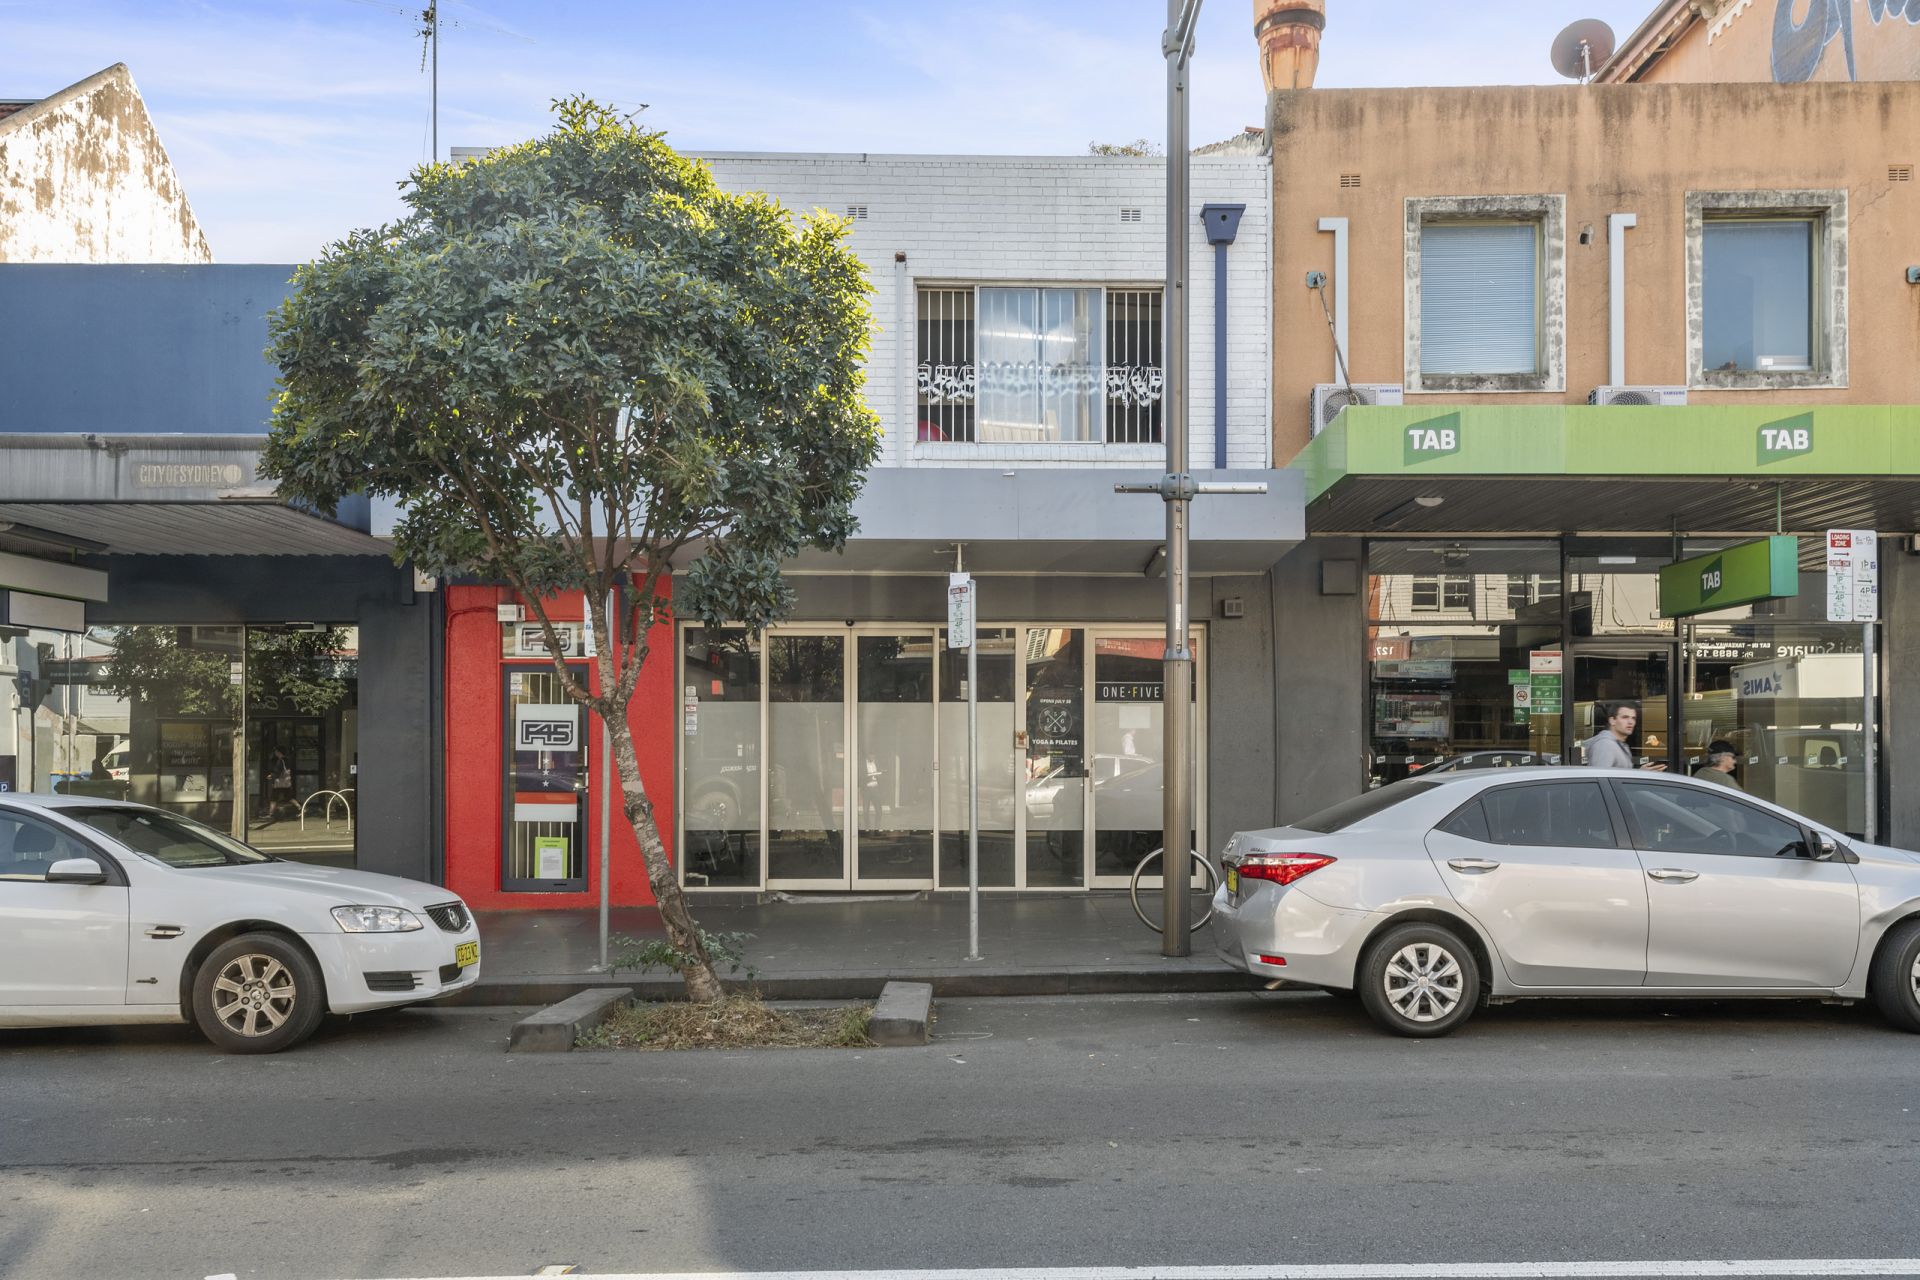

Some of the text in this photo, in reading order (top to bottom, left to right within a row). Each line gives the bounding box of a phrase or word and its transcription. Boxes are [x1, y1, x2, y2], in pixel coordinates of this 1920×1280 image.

[1408, 429, 1456, 450] TAB
[1761, 429, 1809, 450] TAB
[1702, 571, 1720, 590] TAB
[521, 720, 573, 746] F45
